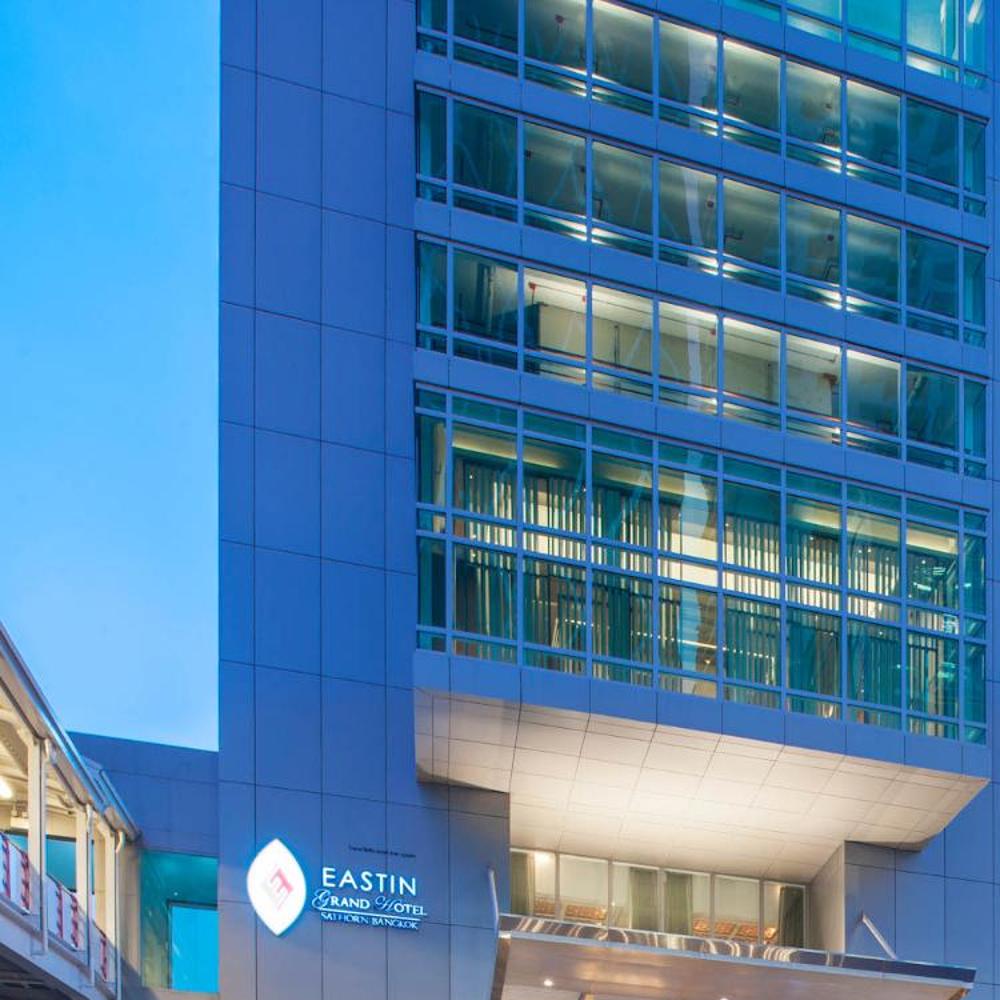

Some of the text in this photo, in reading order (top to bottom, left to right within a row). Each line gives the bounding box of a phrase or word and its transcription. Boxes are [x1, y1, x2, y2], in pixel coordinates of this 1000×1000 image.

[322, 866, 417, 896] EASTIN
[312, 889, 428, 916] GRAND HOTEL
